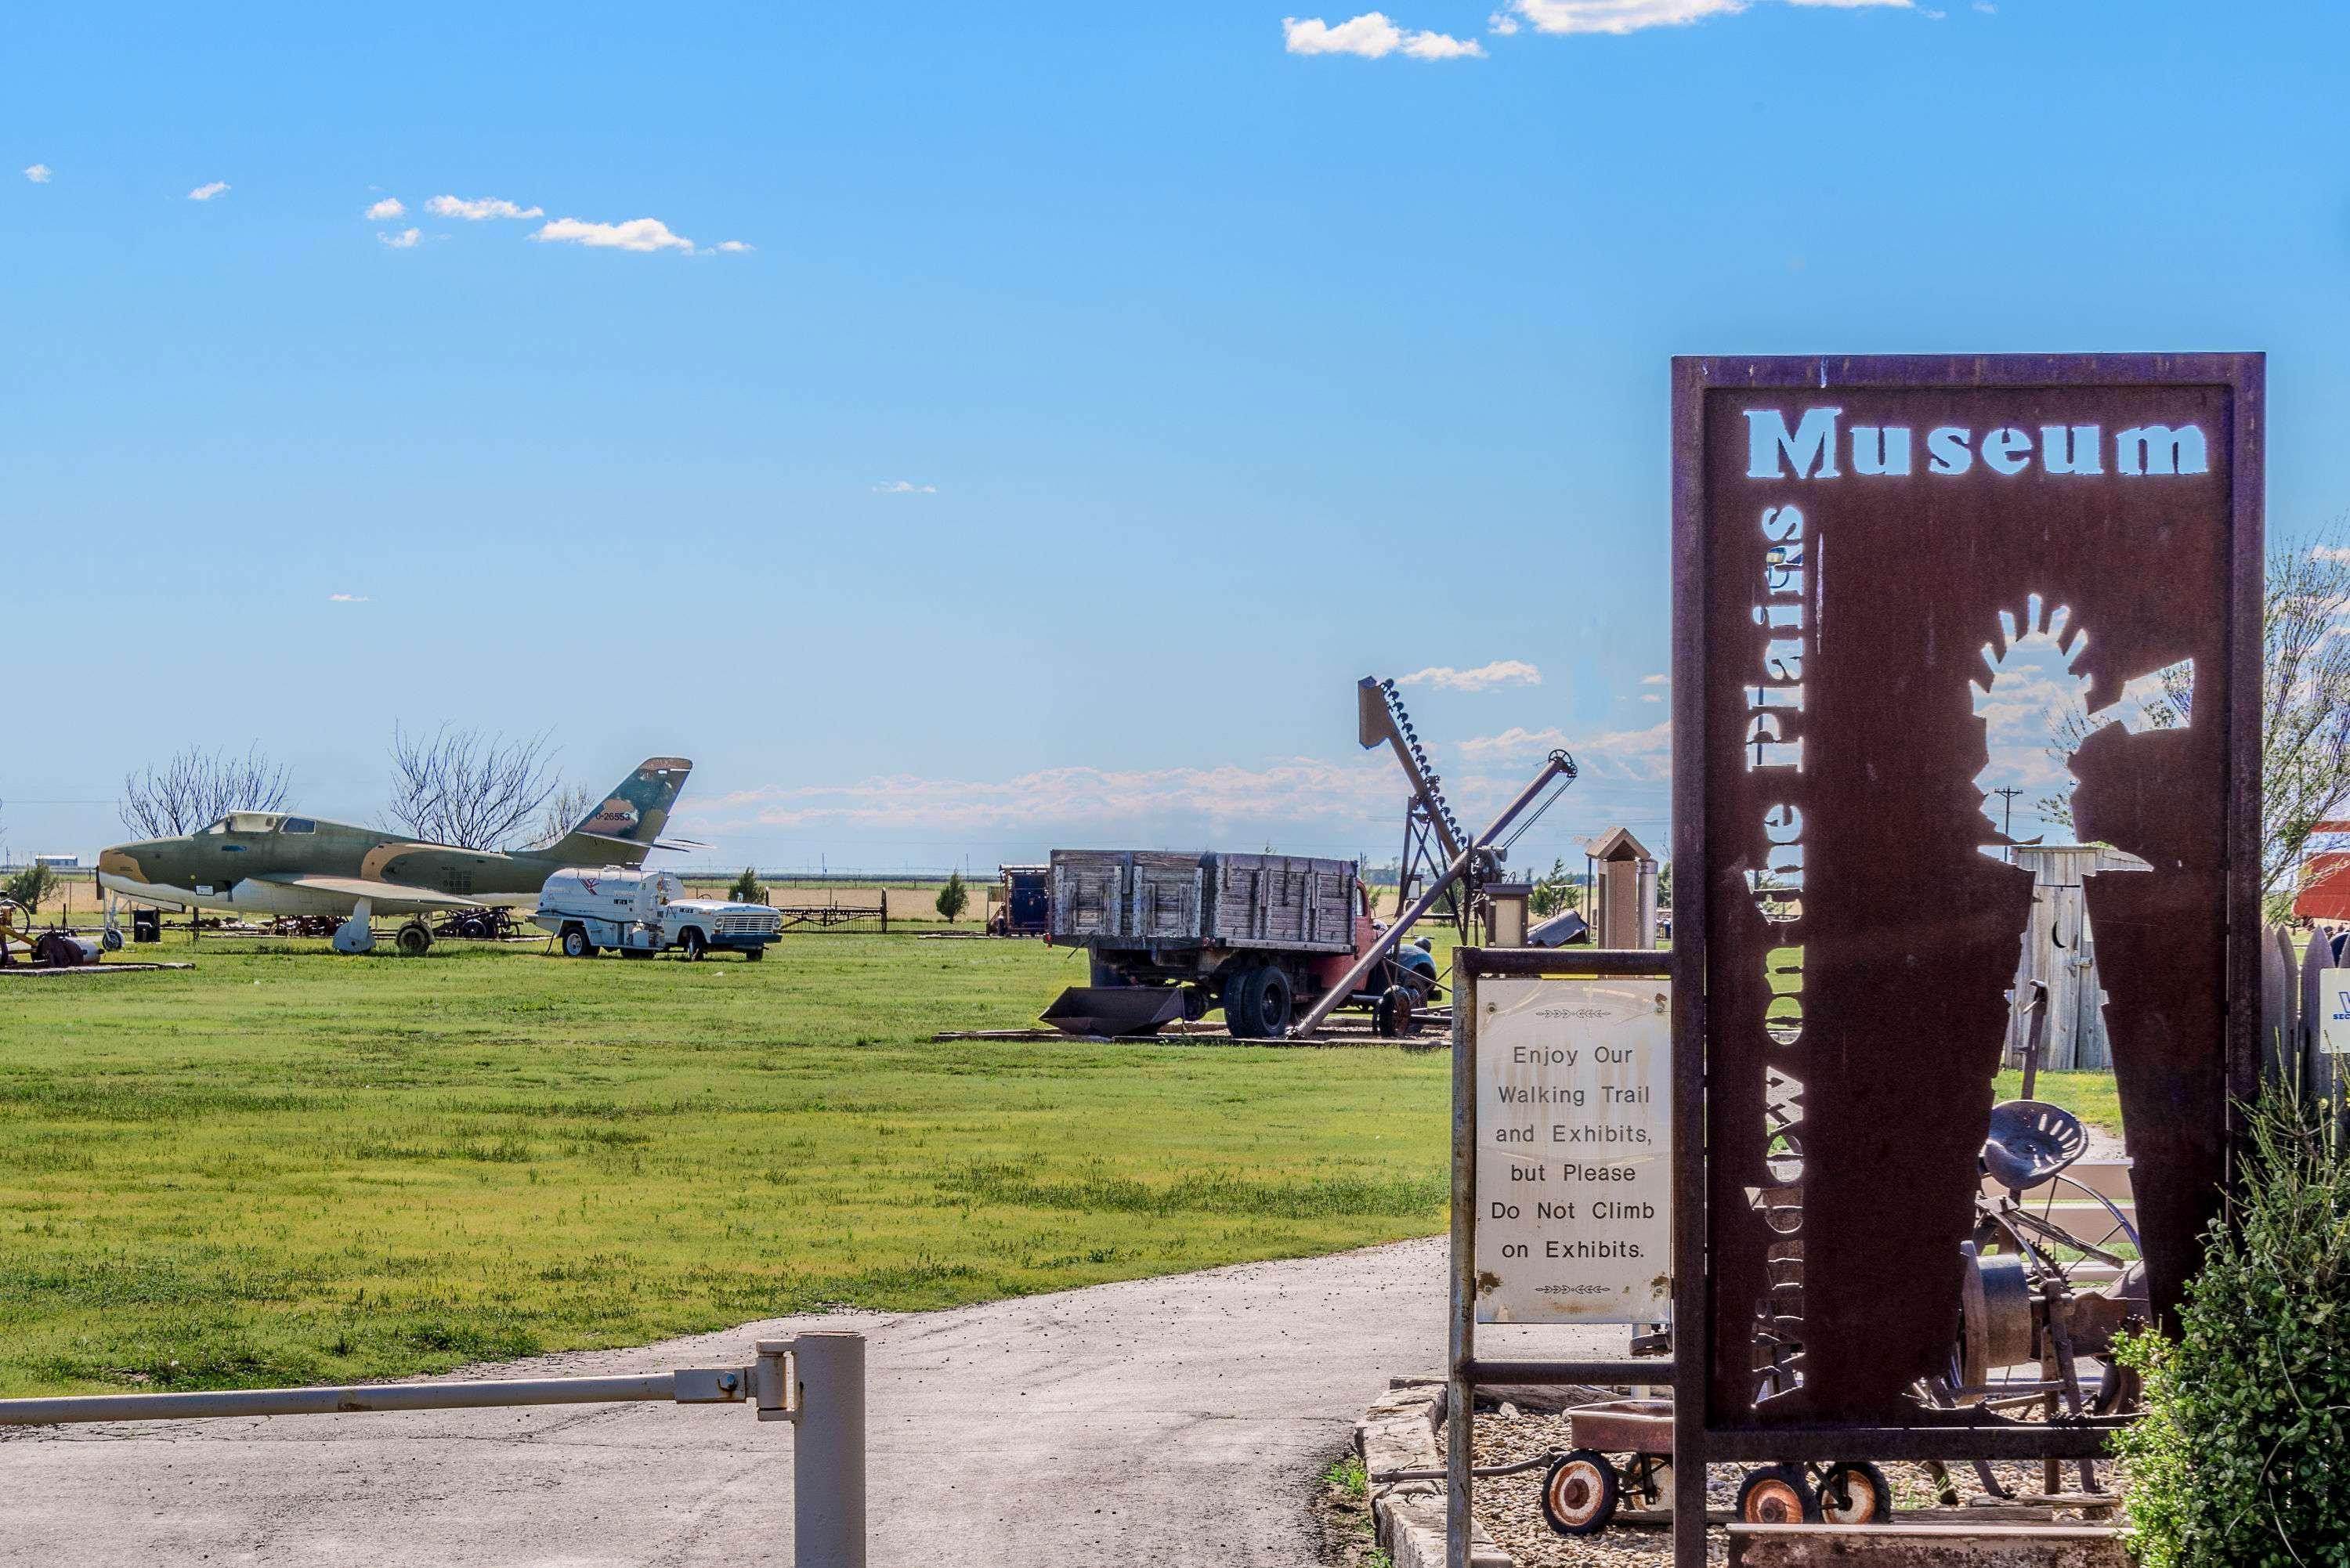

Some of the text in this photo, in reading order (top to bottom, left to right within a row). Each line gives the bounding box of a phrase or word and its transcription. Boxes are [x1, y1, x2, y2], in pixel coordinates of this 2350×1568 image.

[1742, 406, 2210, 480] Museum
[1743, 504, 1806, 1409] Window on the Plains
[1513, 1046, 1633, 1067] Enjoy Our
[1498, 1086, 1650, 1107] Walking Trail
[1495, 1124, 1652, 1146] and Exhibits,
[1511, 1163, 1636, 1182] but Please
[1491, 1201, 1655, 1219] Do Not Climb
[1502, 1240, 1645, 1259] on Exhibits.
